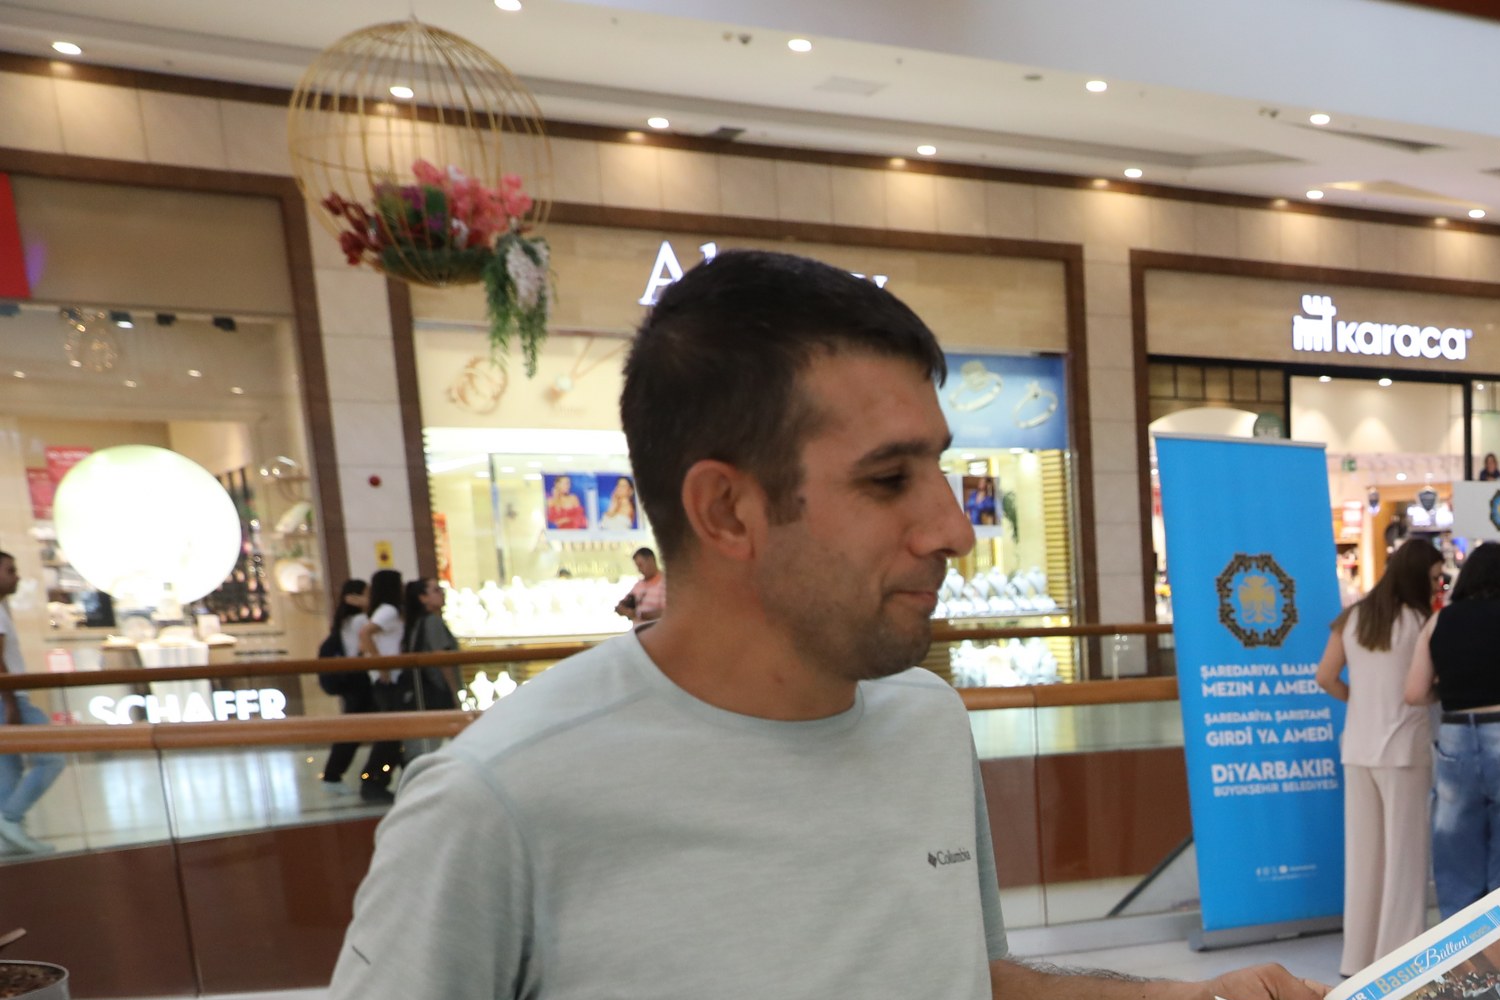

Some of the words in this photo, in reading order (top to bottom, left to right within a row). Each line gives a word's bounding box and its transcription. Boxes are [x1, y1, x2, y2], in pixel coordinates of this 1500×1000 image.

[1336, 321, 1467, 360] karaca
[1258, 681, 1271, 696] A
[1274, 679, 1327, 695] AMED
[1257, 729, 1279, 744] YA
[936, 847, 971, 866] Columbia
